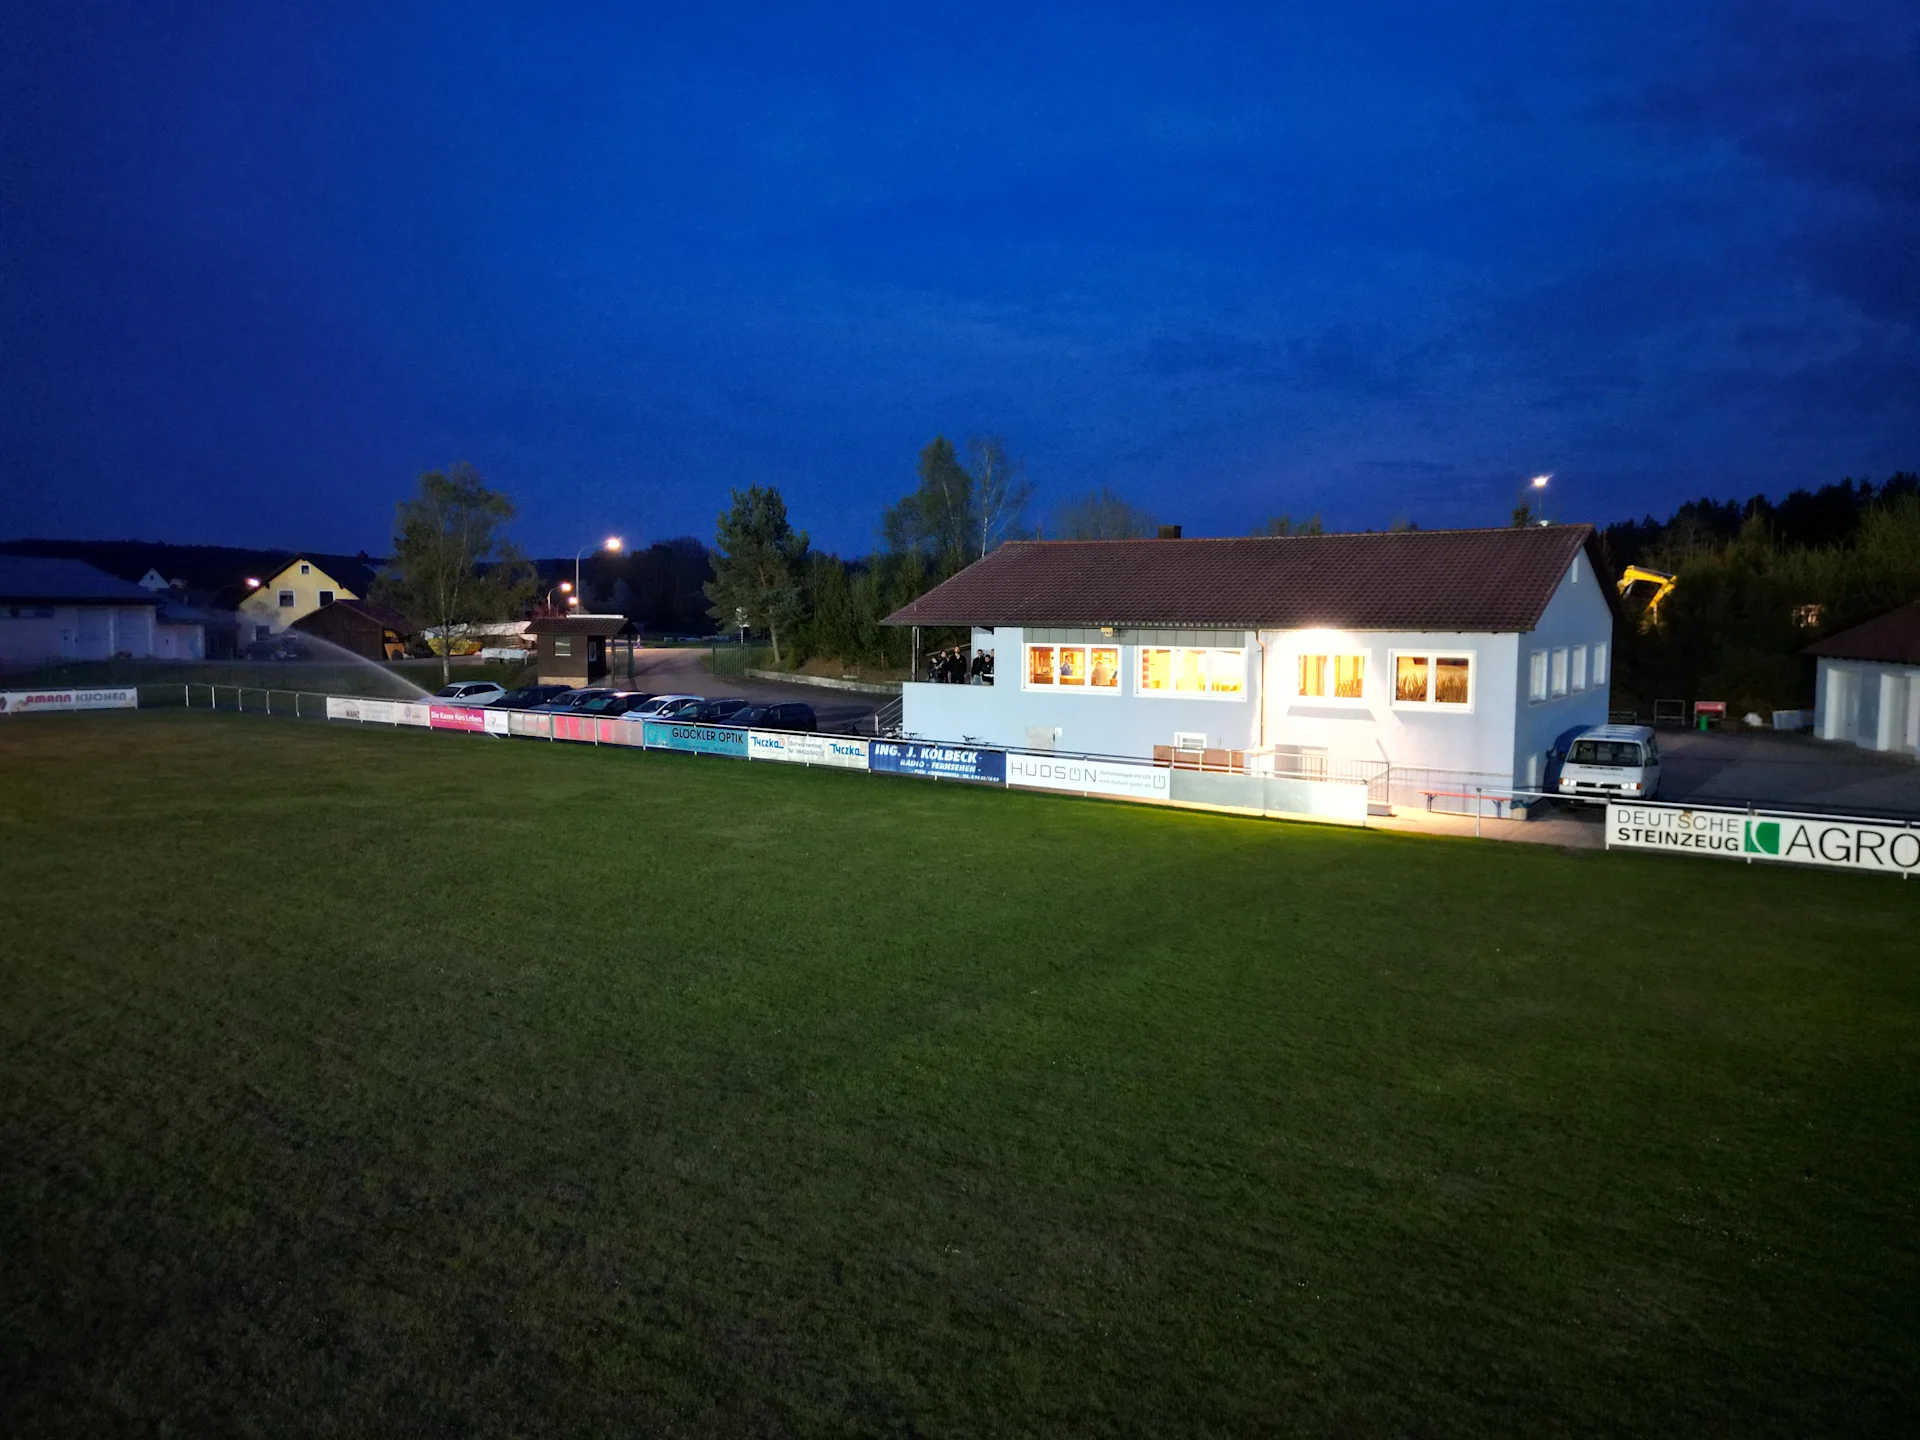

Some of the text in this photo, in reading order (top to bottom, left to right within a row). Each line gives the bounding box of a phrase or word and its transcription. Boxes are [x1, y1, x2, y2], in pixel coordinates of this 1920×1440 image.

[430, 711, 440, 719] Die
[439, 712, 455, 720] Kasse
[718, 732, 744, 744] OPTIK
[751, 736, 785, 749] Tyczka
[829, 743, 866, 757] Tyczka
[874, 743, 978, 764] ING. J. KOLBECK
[899, 759, 977, 773] RADIO FERNSEHEN
[1617, 809, 1740, 834] DEUTSCHE
[1617, 827, 1740, 852] STEINZEUG
